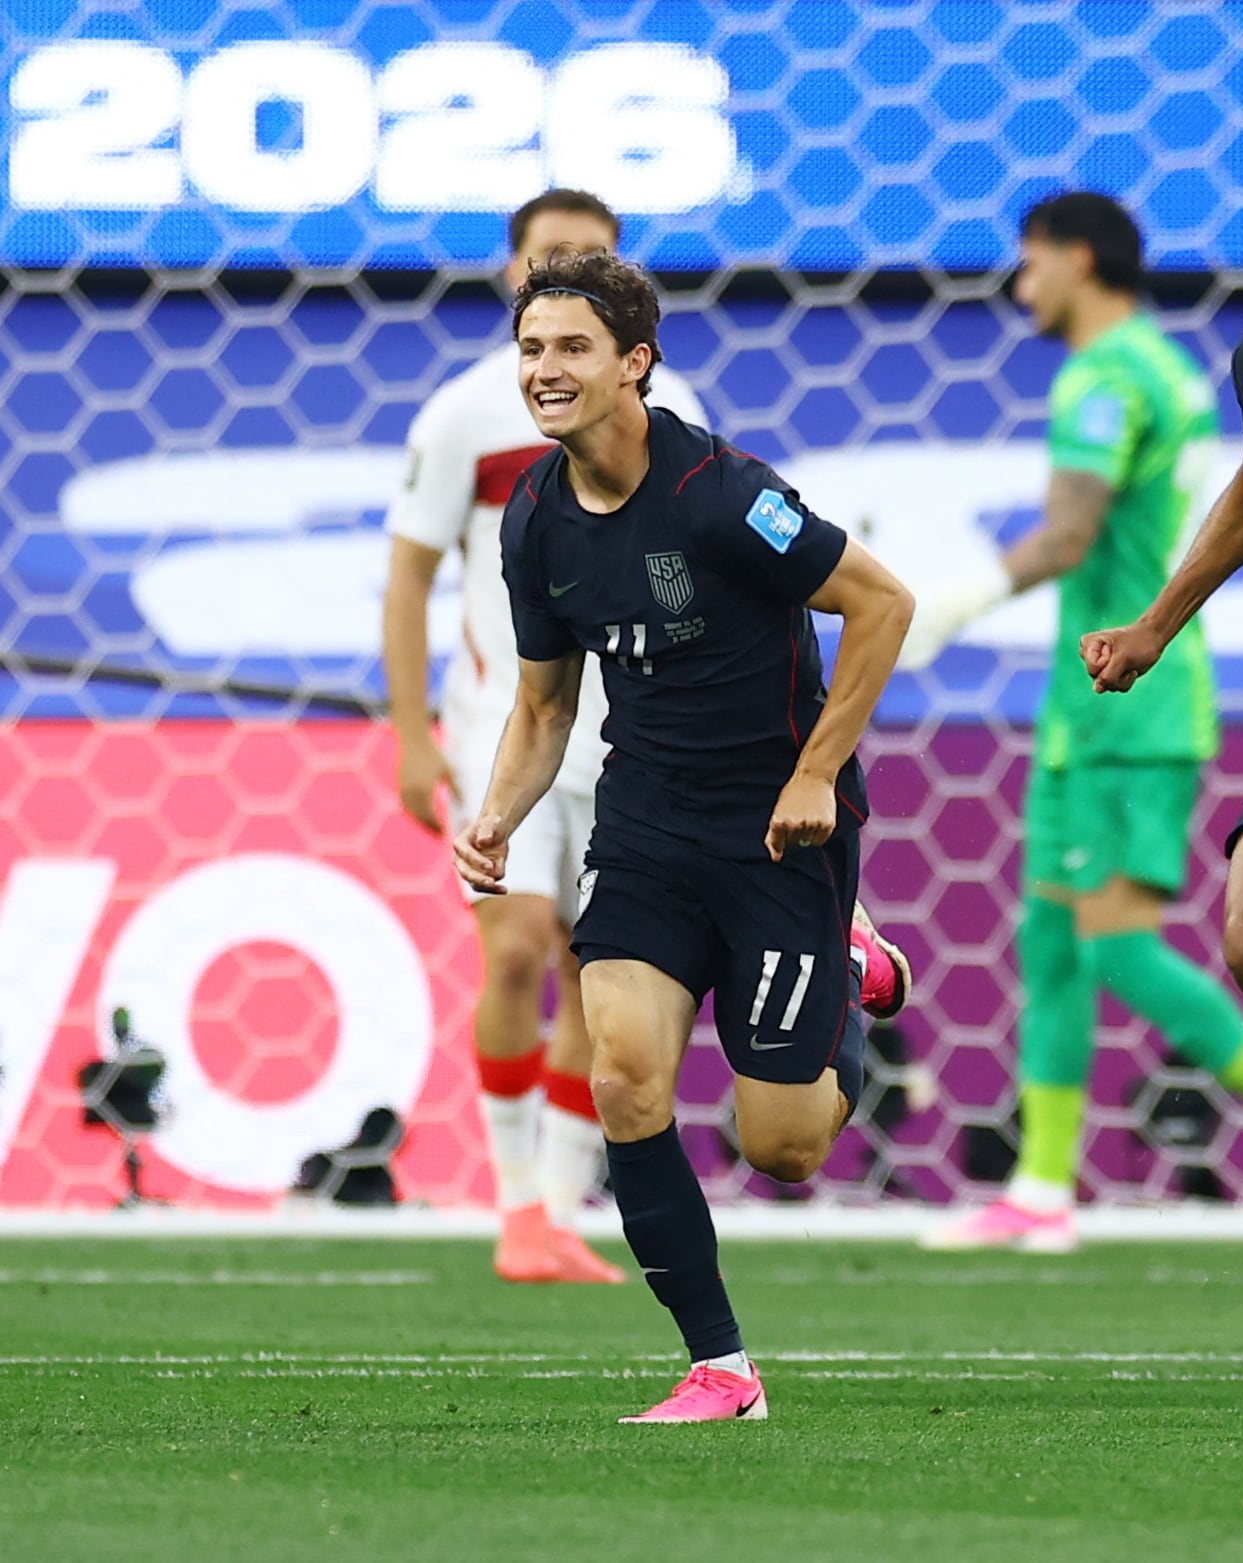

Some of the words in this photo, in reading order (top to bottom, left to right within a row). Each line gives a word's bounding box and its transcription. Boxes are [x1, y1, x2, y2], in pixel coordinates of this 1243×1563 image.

[8, 38, 738, 213] 2026
[649, 554, 684, 581] USA
[605, 623, 653, 676] 11
[748, 950, 815, 1031] 11
